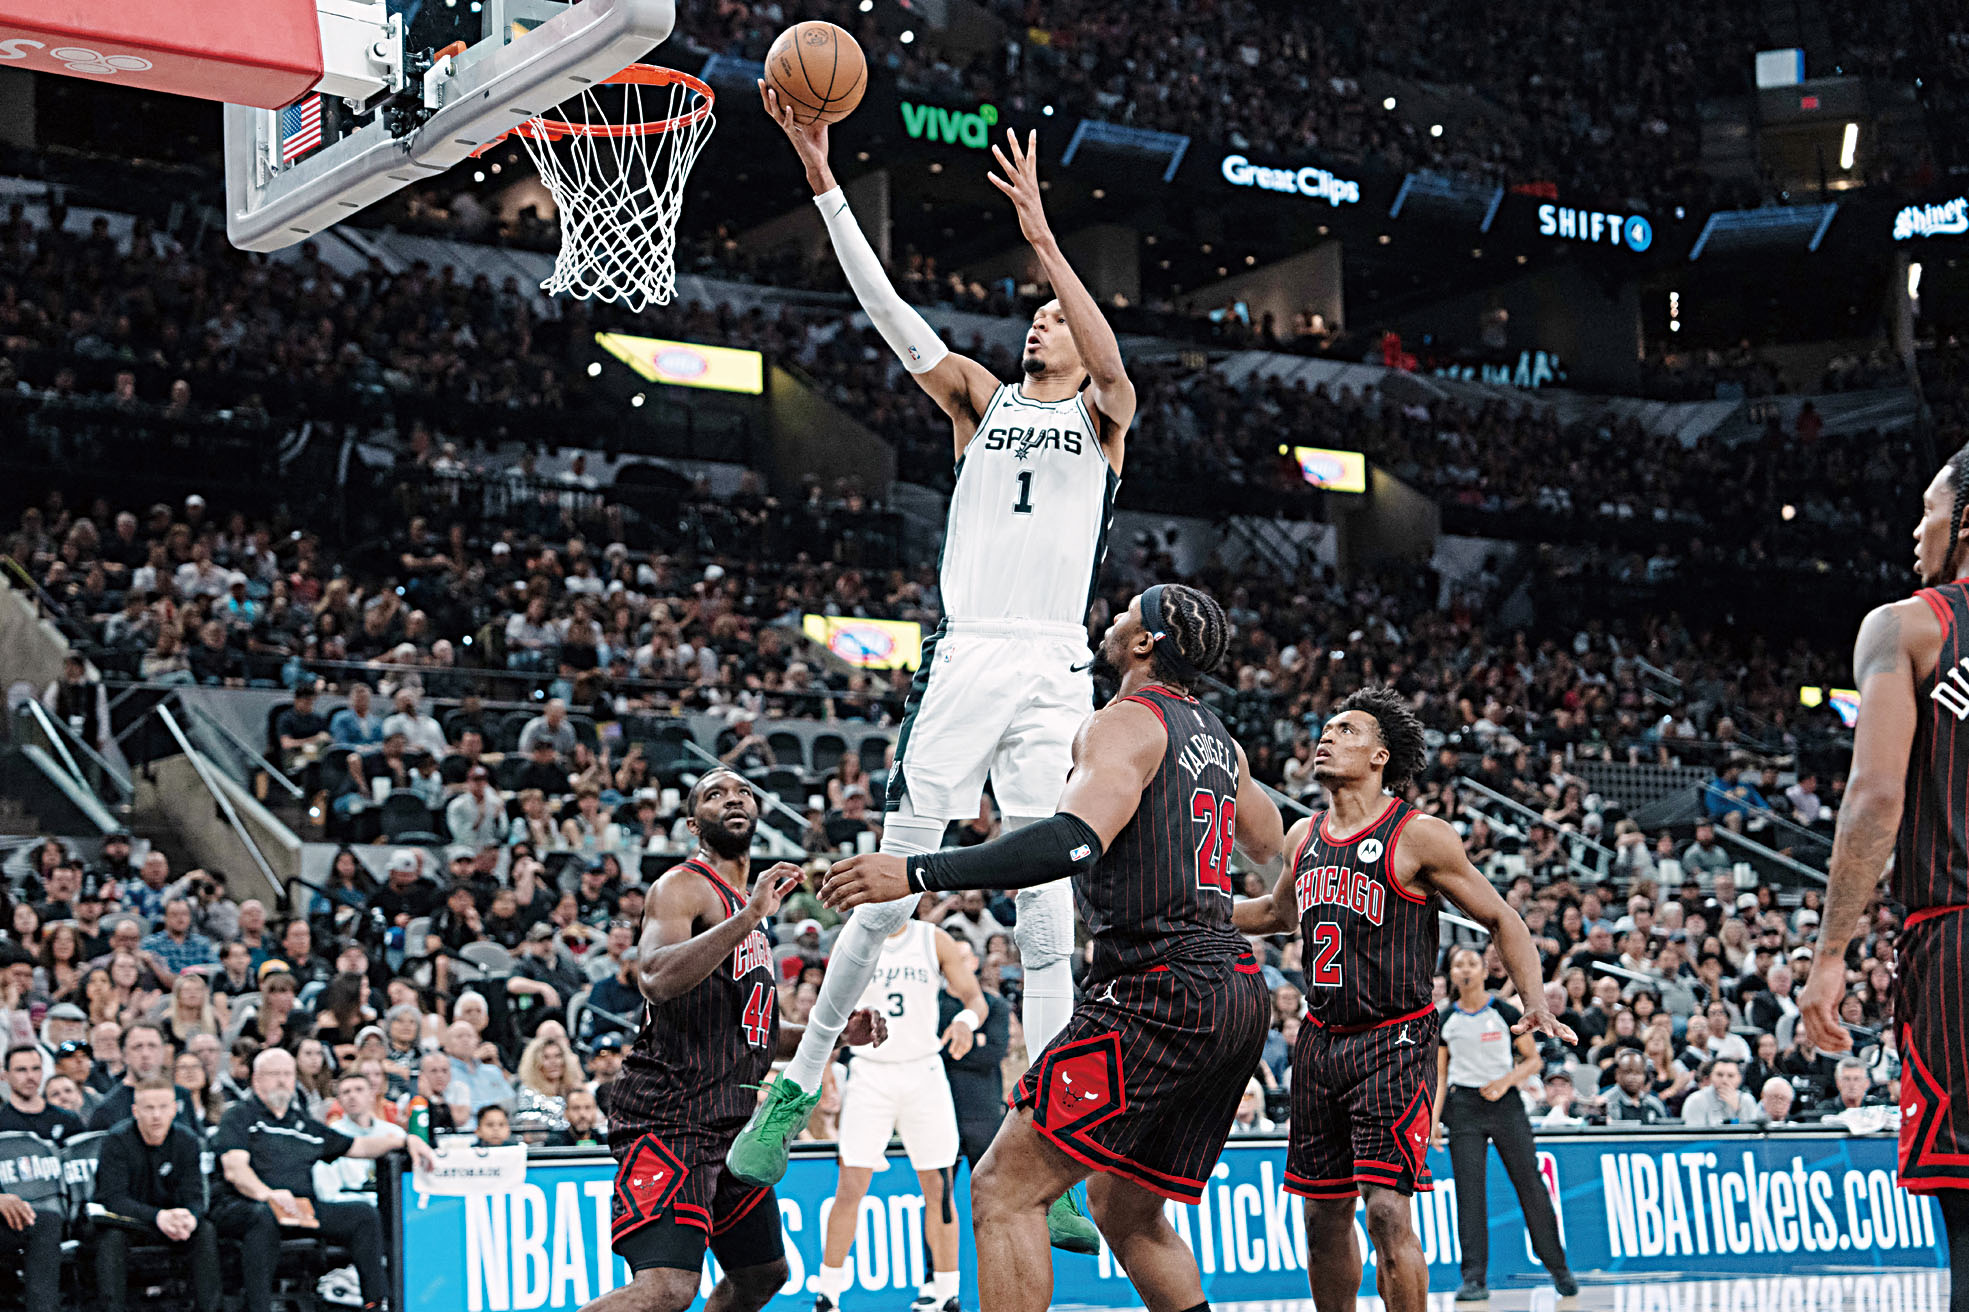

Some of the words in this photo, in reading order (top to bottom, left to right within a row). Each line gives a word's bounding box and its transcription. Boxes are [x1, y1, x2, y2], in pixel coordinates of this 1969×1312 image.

[985, 426, 1082, 461] SPURS
[1012, 469, 1035, 515] 1
[1190, 787, 1237, 899] 28
[872, 966, 929, 988] PURS
[1313, 922, 1343, 988] 2
[741, 981, 776, 1049] 44
[887, 992, 905, 1018] 3
[1600, 1151, 1936, 1258] NBATickets.com
